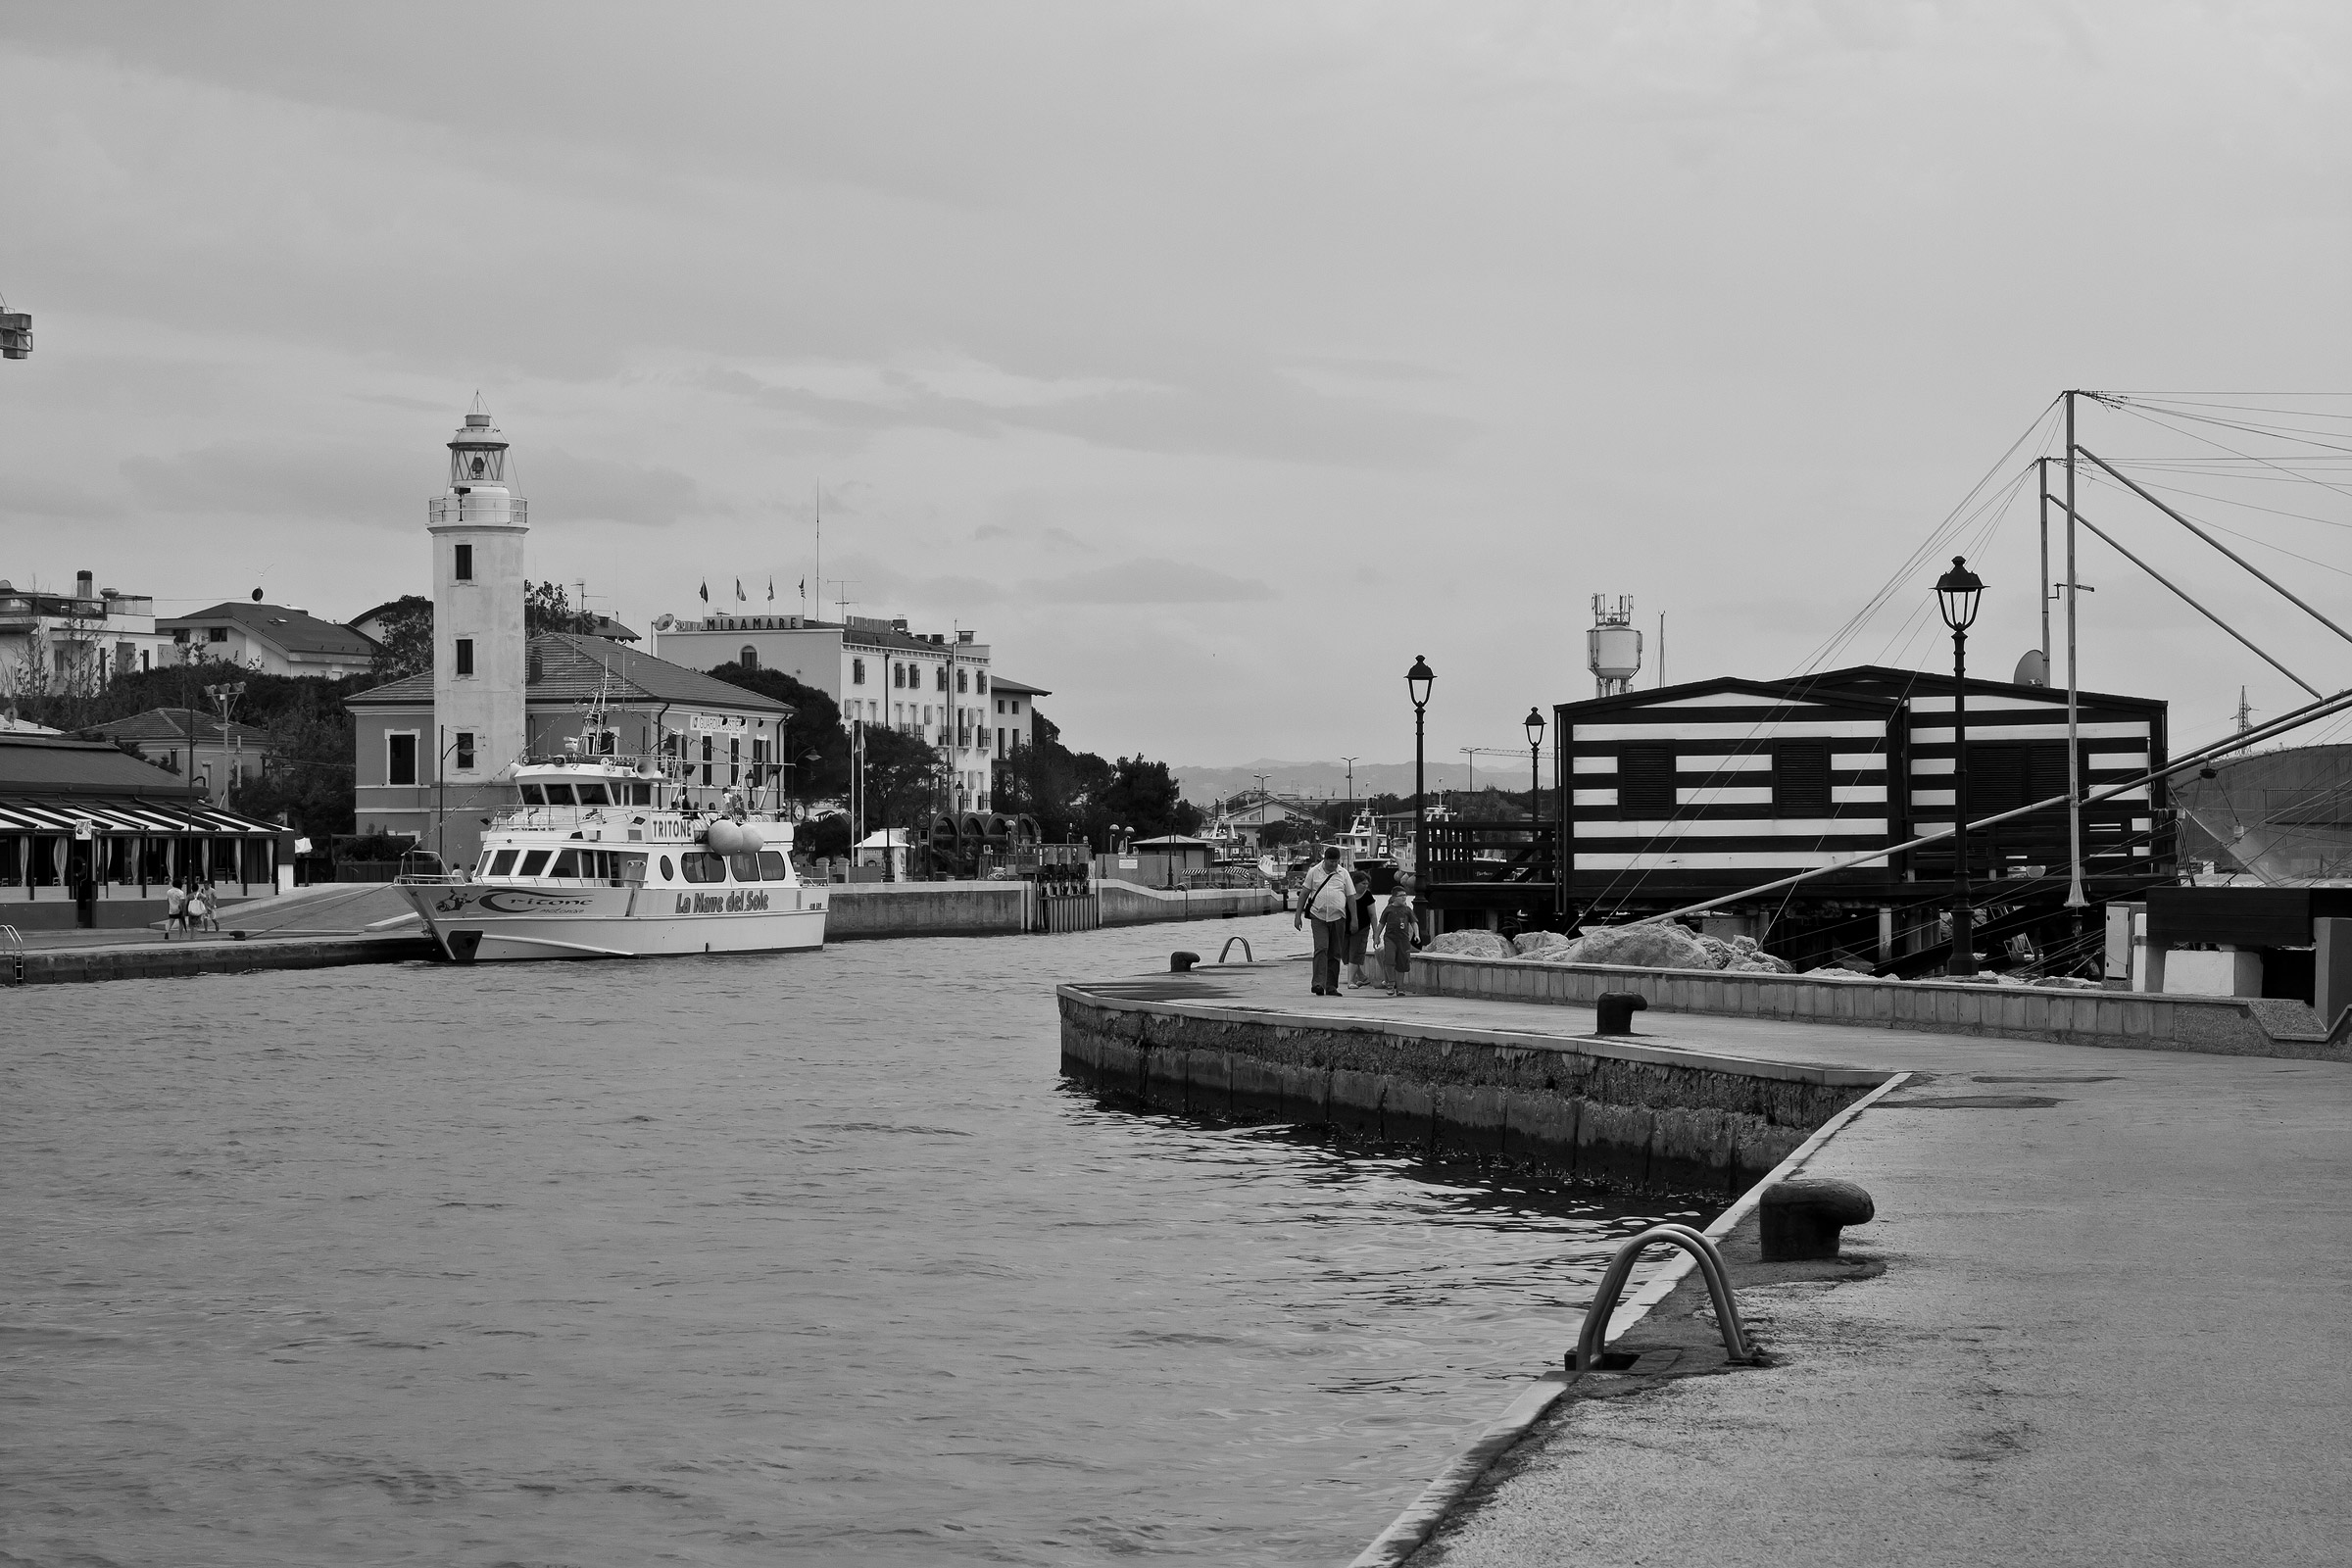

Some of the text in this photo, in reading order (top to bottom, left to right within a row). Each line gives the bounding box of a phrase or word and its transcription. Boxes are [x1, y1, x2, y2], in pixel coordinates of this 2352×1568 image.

[707, 617, 797, 630] MIRAMARE
[700, 716, 722, 730] GUARDIA
[653, 820, 692, 838] TRITONE
[675, 889, 769, 913] La Nave del Sole
